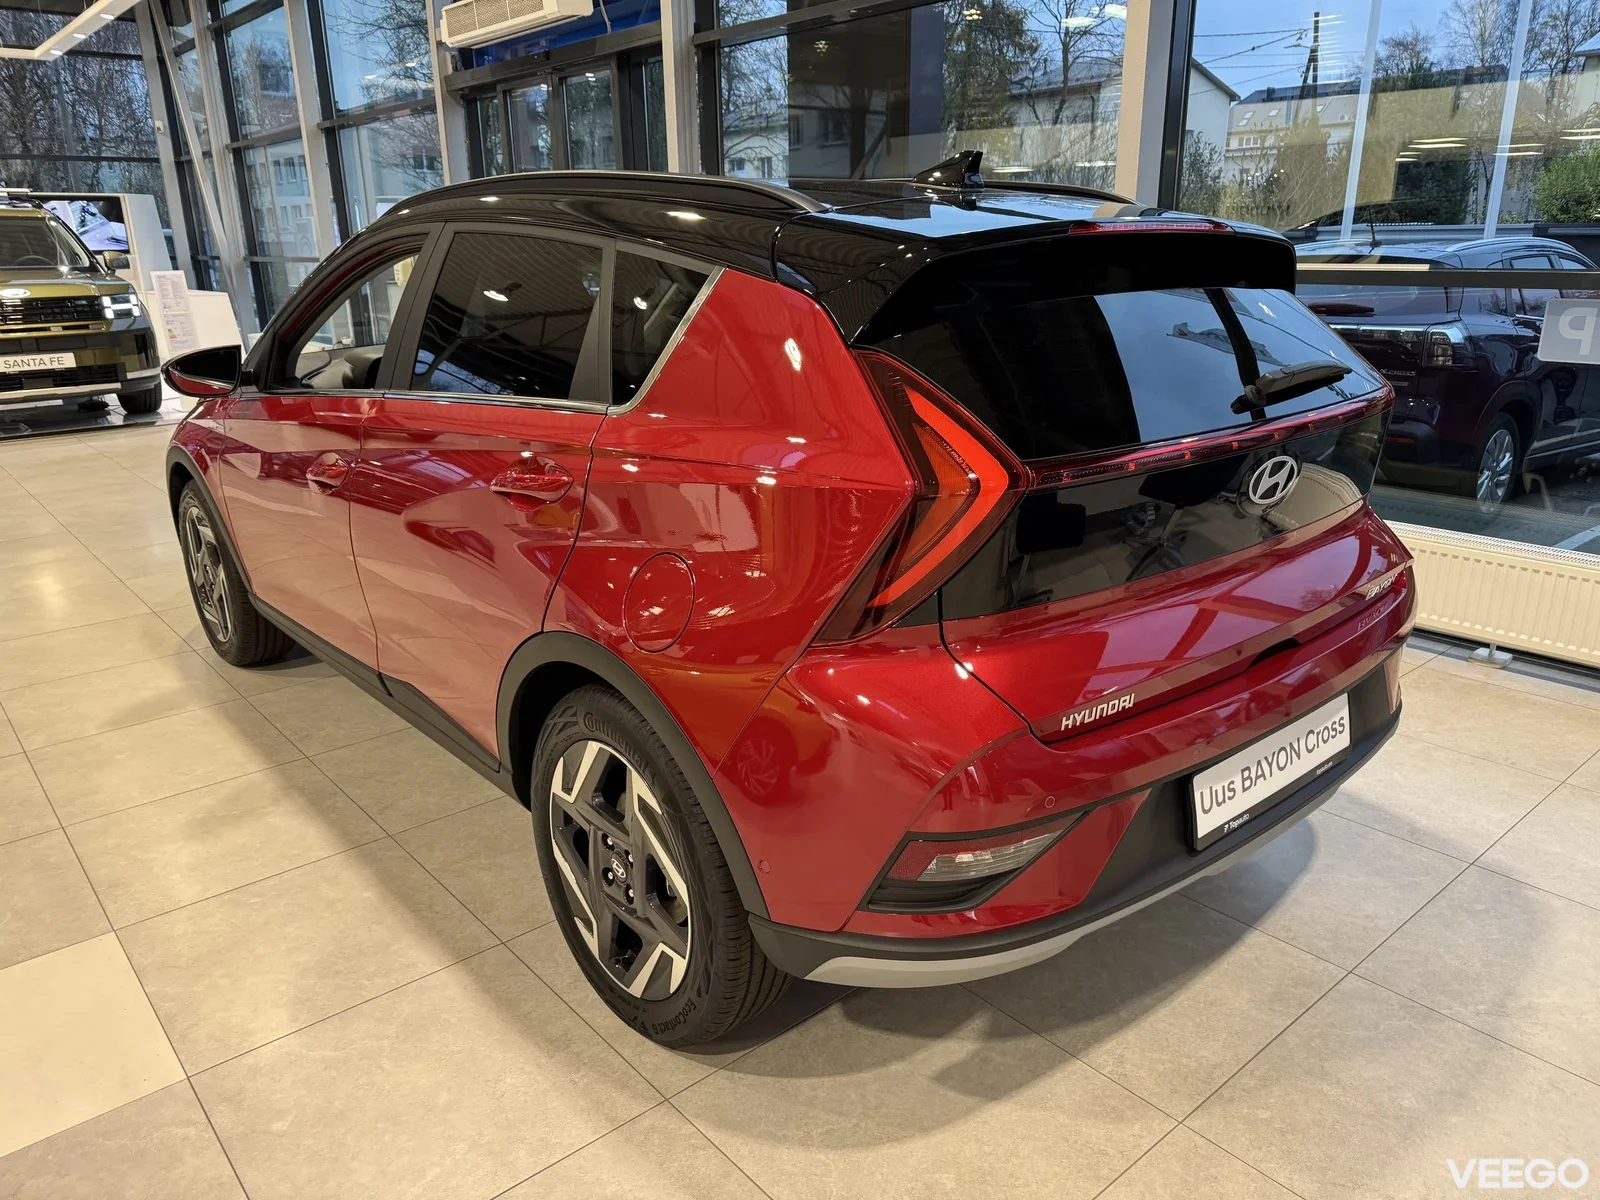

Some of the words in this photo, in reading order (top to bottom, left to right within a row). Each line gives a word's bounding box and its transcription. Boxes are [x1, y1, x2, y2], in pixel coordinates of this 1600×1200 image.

[3, 358, 47, 369] SANTA
[49, 356, 65, 366] FE
[1061, 693, 1135, 731] HYUNDAI
[583, 712, 649, 776] Continental
[1200, 780, 1237, 815] Uus
[1240, 736, 1301, 793] BAYON
[1304, 716, 1346, 754] Cross
